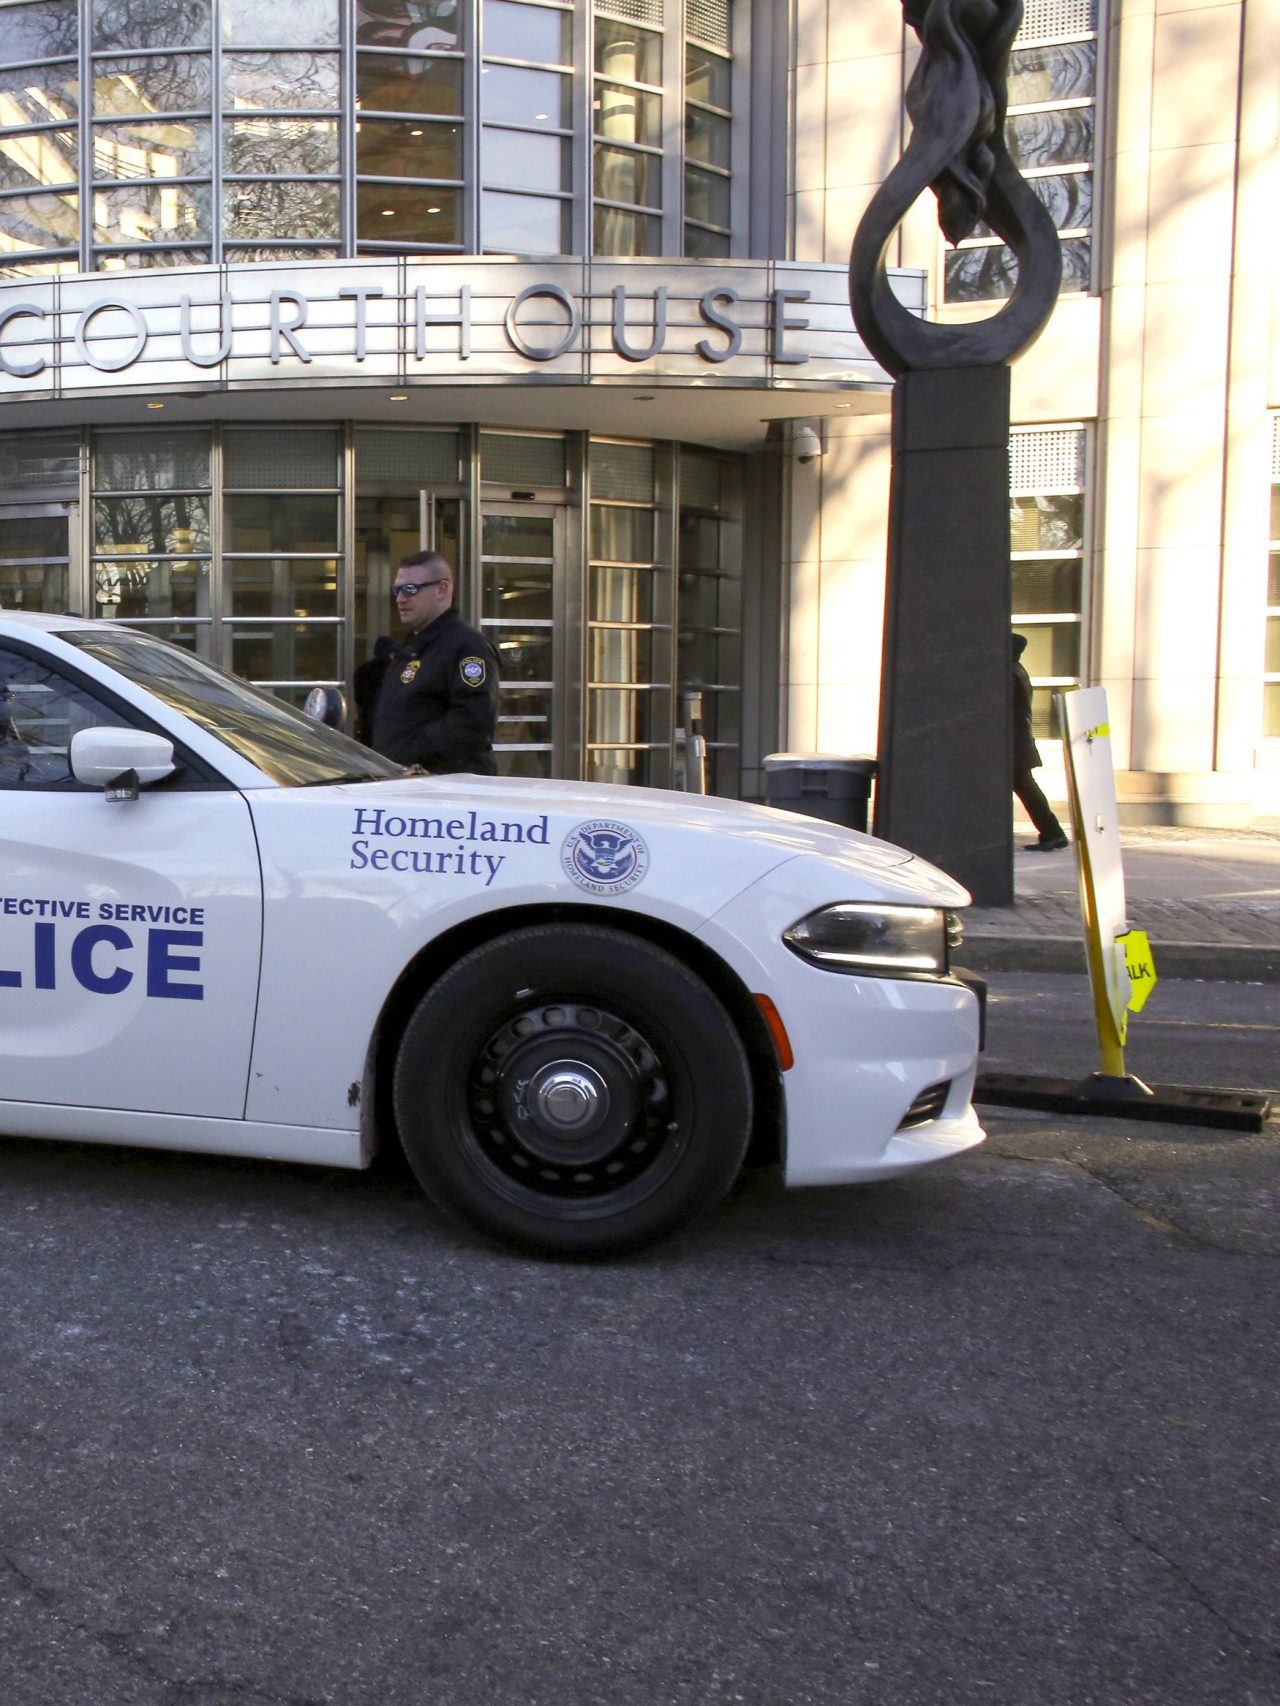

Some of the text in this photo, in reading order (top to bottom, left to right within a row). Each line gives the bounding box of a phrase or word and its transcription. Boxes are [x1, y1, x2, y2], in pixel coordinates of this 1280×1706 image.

[351, 808, 551, 844] Homeland
[580, 822, 640, 844] DEPARTMENT
[350, 840, 506, 886] Security
[564, 857, 645, 893] HOMELAND SECURITY
[98, 903, 205, 926] SERVICE
